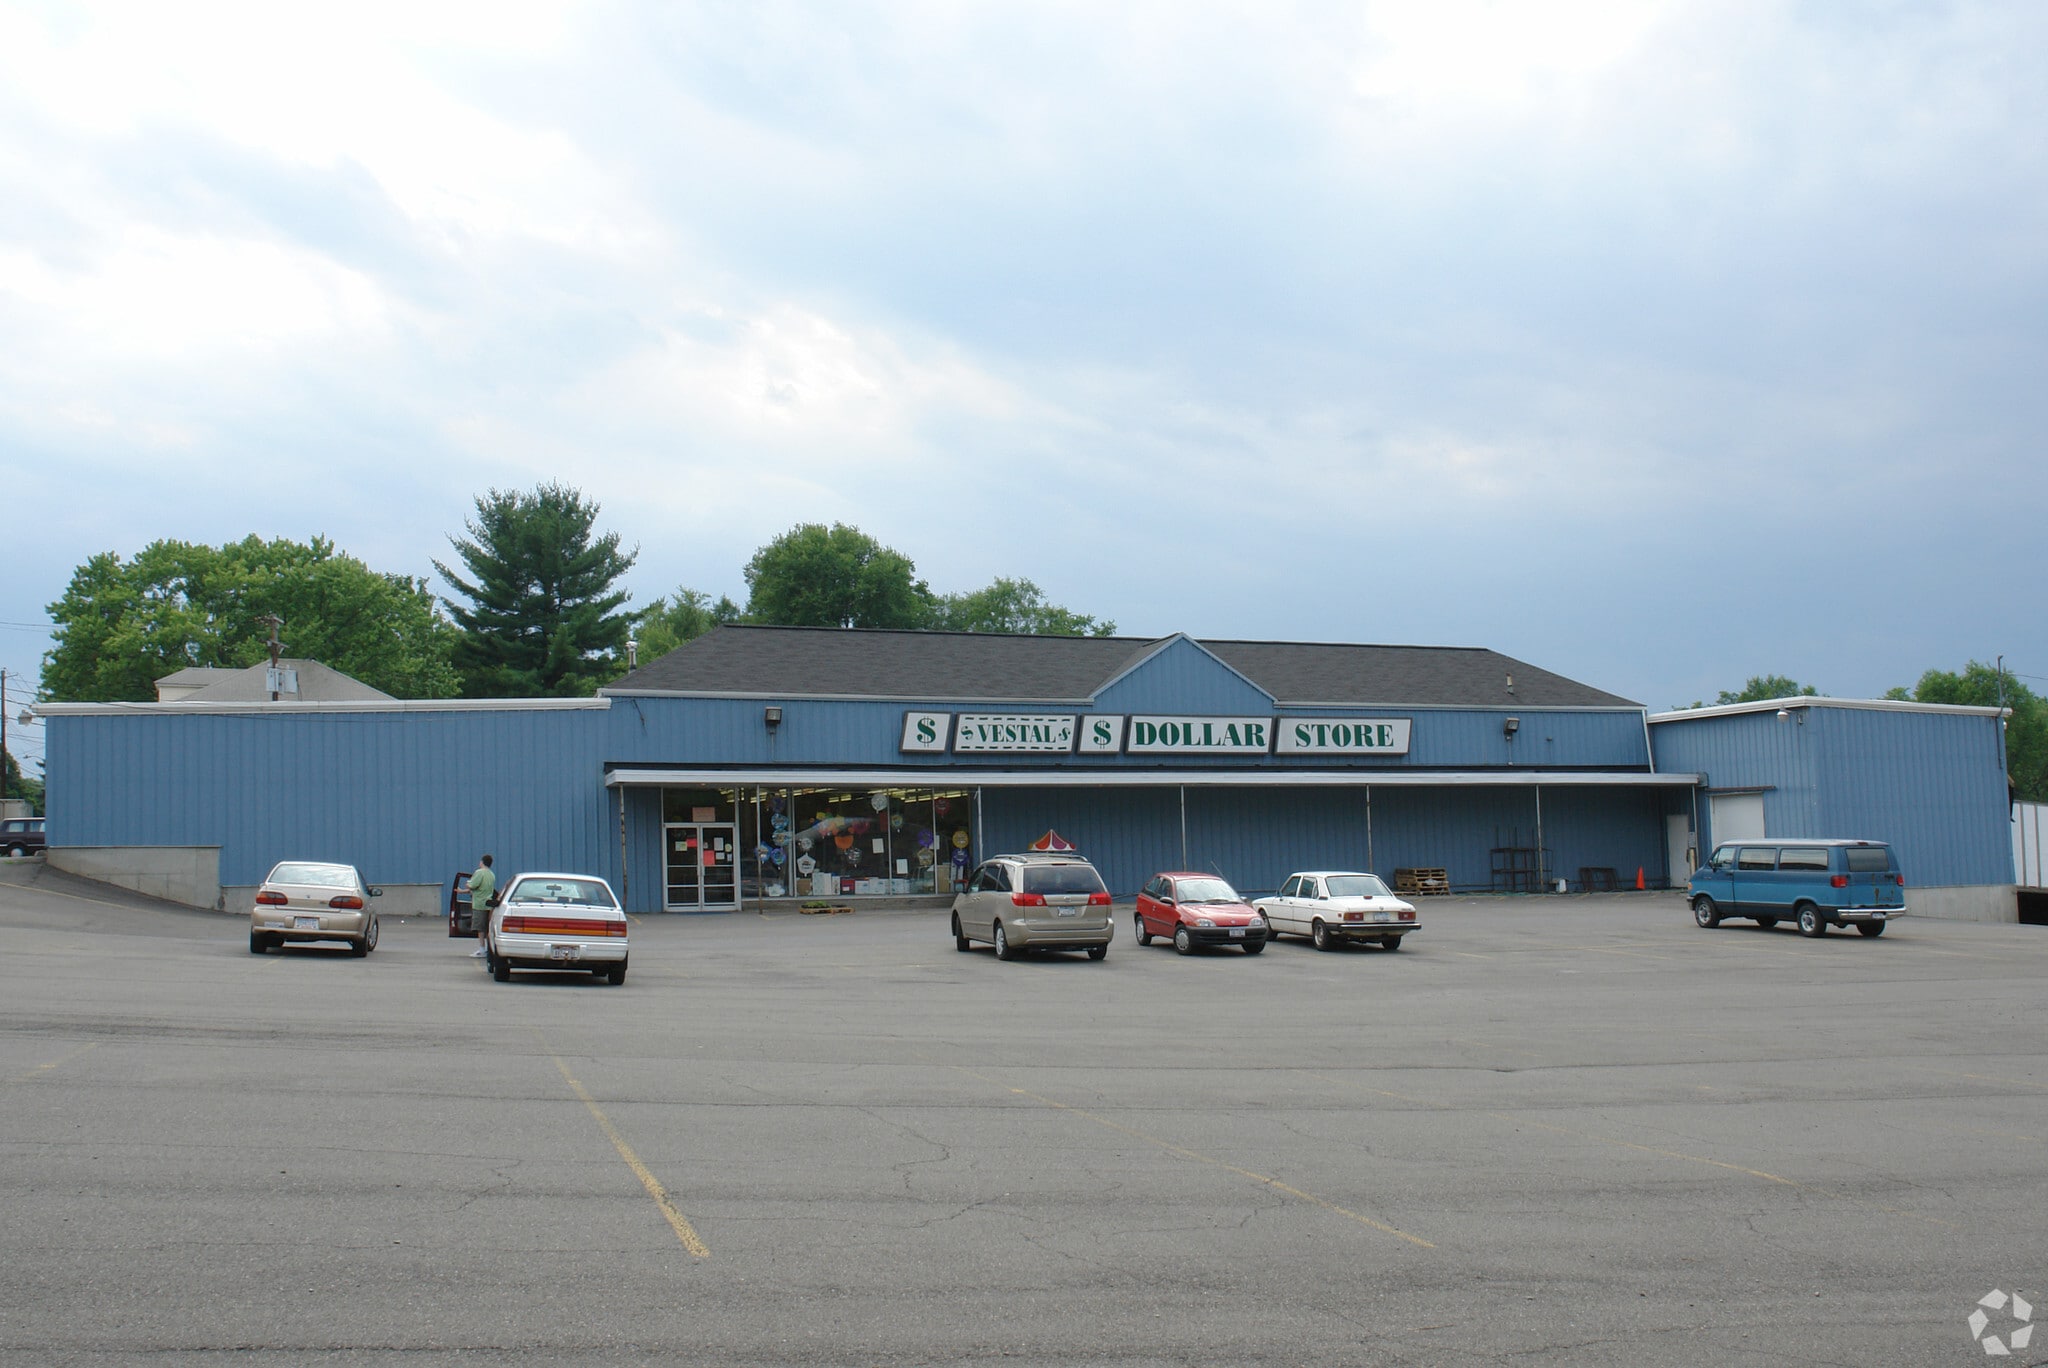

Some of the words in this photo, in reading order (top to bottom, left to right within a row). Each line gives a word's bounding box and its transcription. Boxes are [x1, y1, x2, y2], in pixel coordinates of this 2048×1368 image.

[977, 724, 1056, 743] VESTAL
[1133, 721, 1266, 747] DOLLAR
[1294, 722, 1395, 748] STORE
